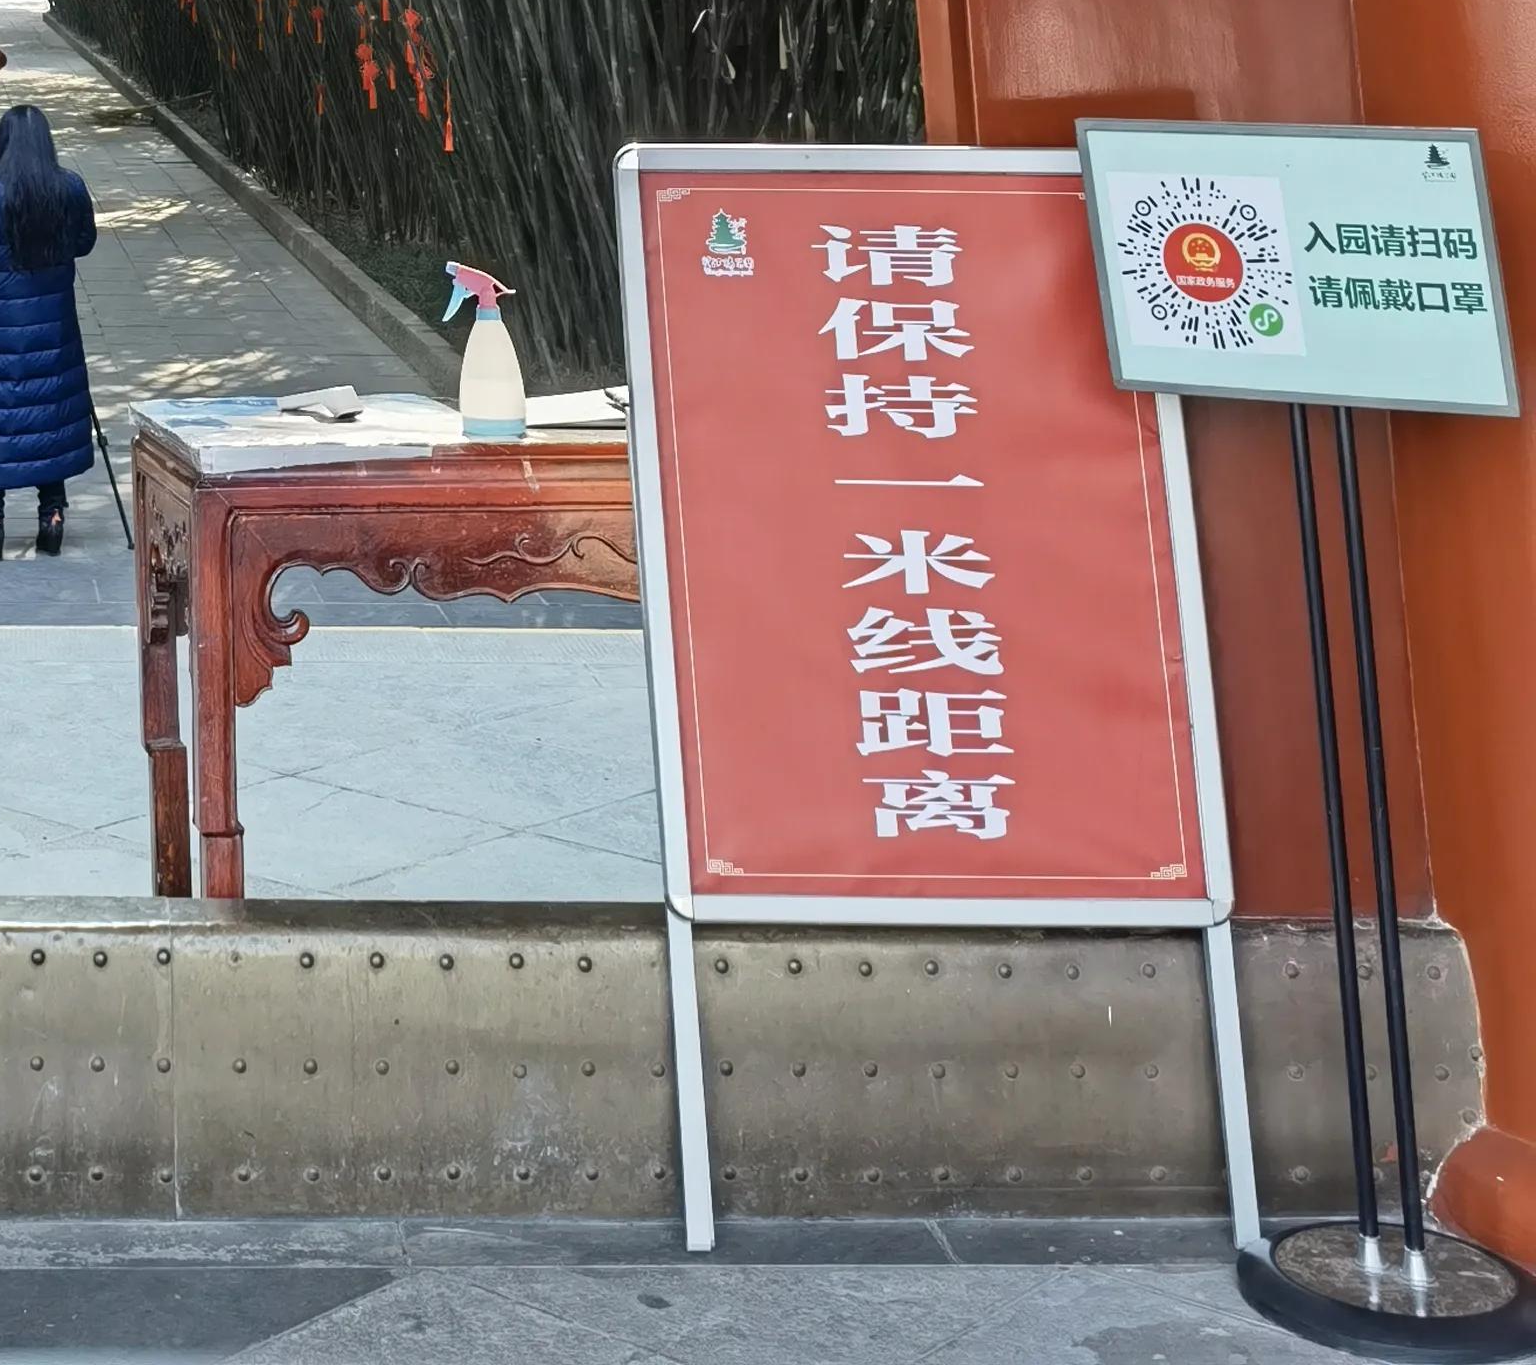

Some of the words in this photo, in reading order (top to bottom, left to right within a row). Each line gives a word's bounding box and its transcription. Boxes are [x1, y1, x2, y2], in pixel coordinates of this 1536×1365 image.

[1304, 221, 1477, 260] 入园请扫码
[1309, 275, 1488, 314] 请佩戴口罩
[810, 224, 1016, 841] 请保持一米线距离
